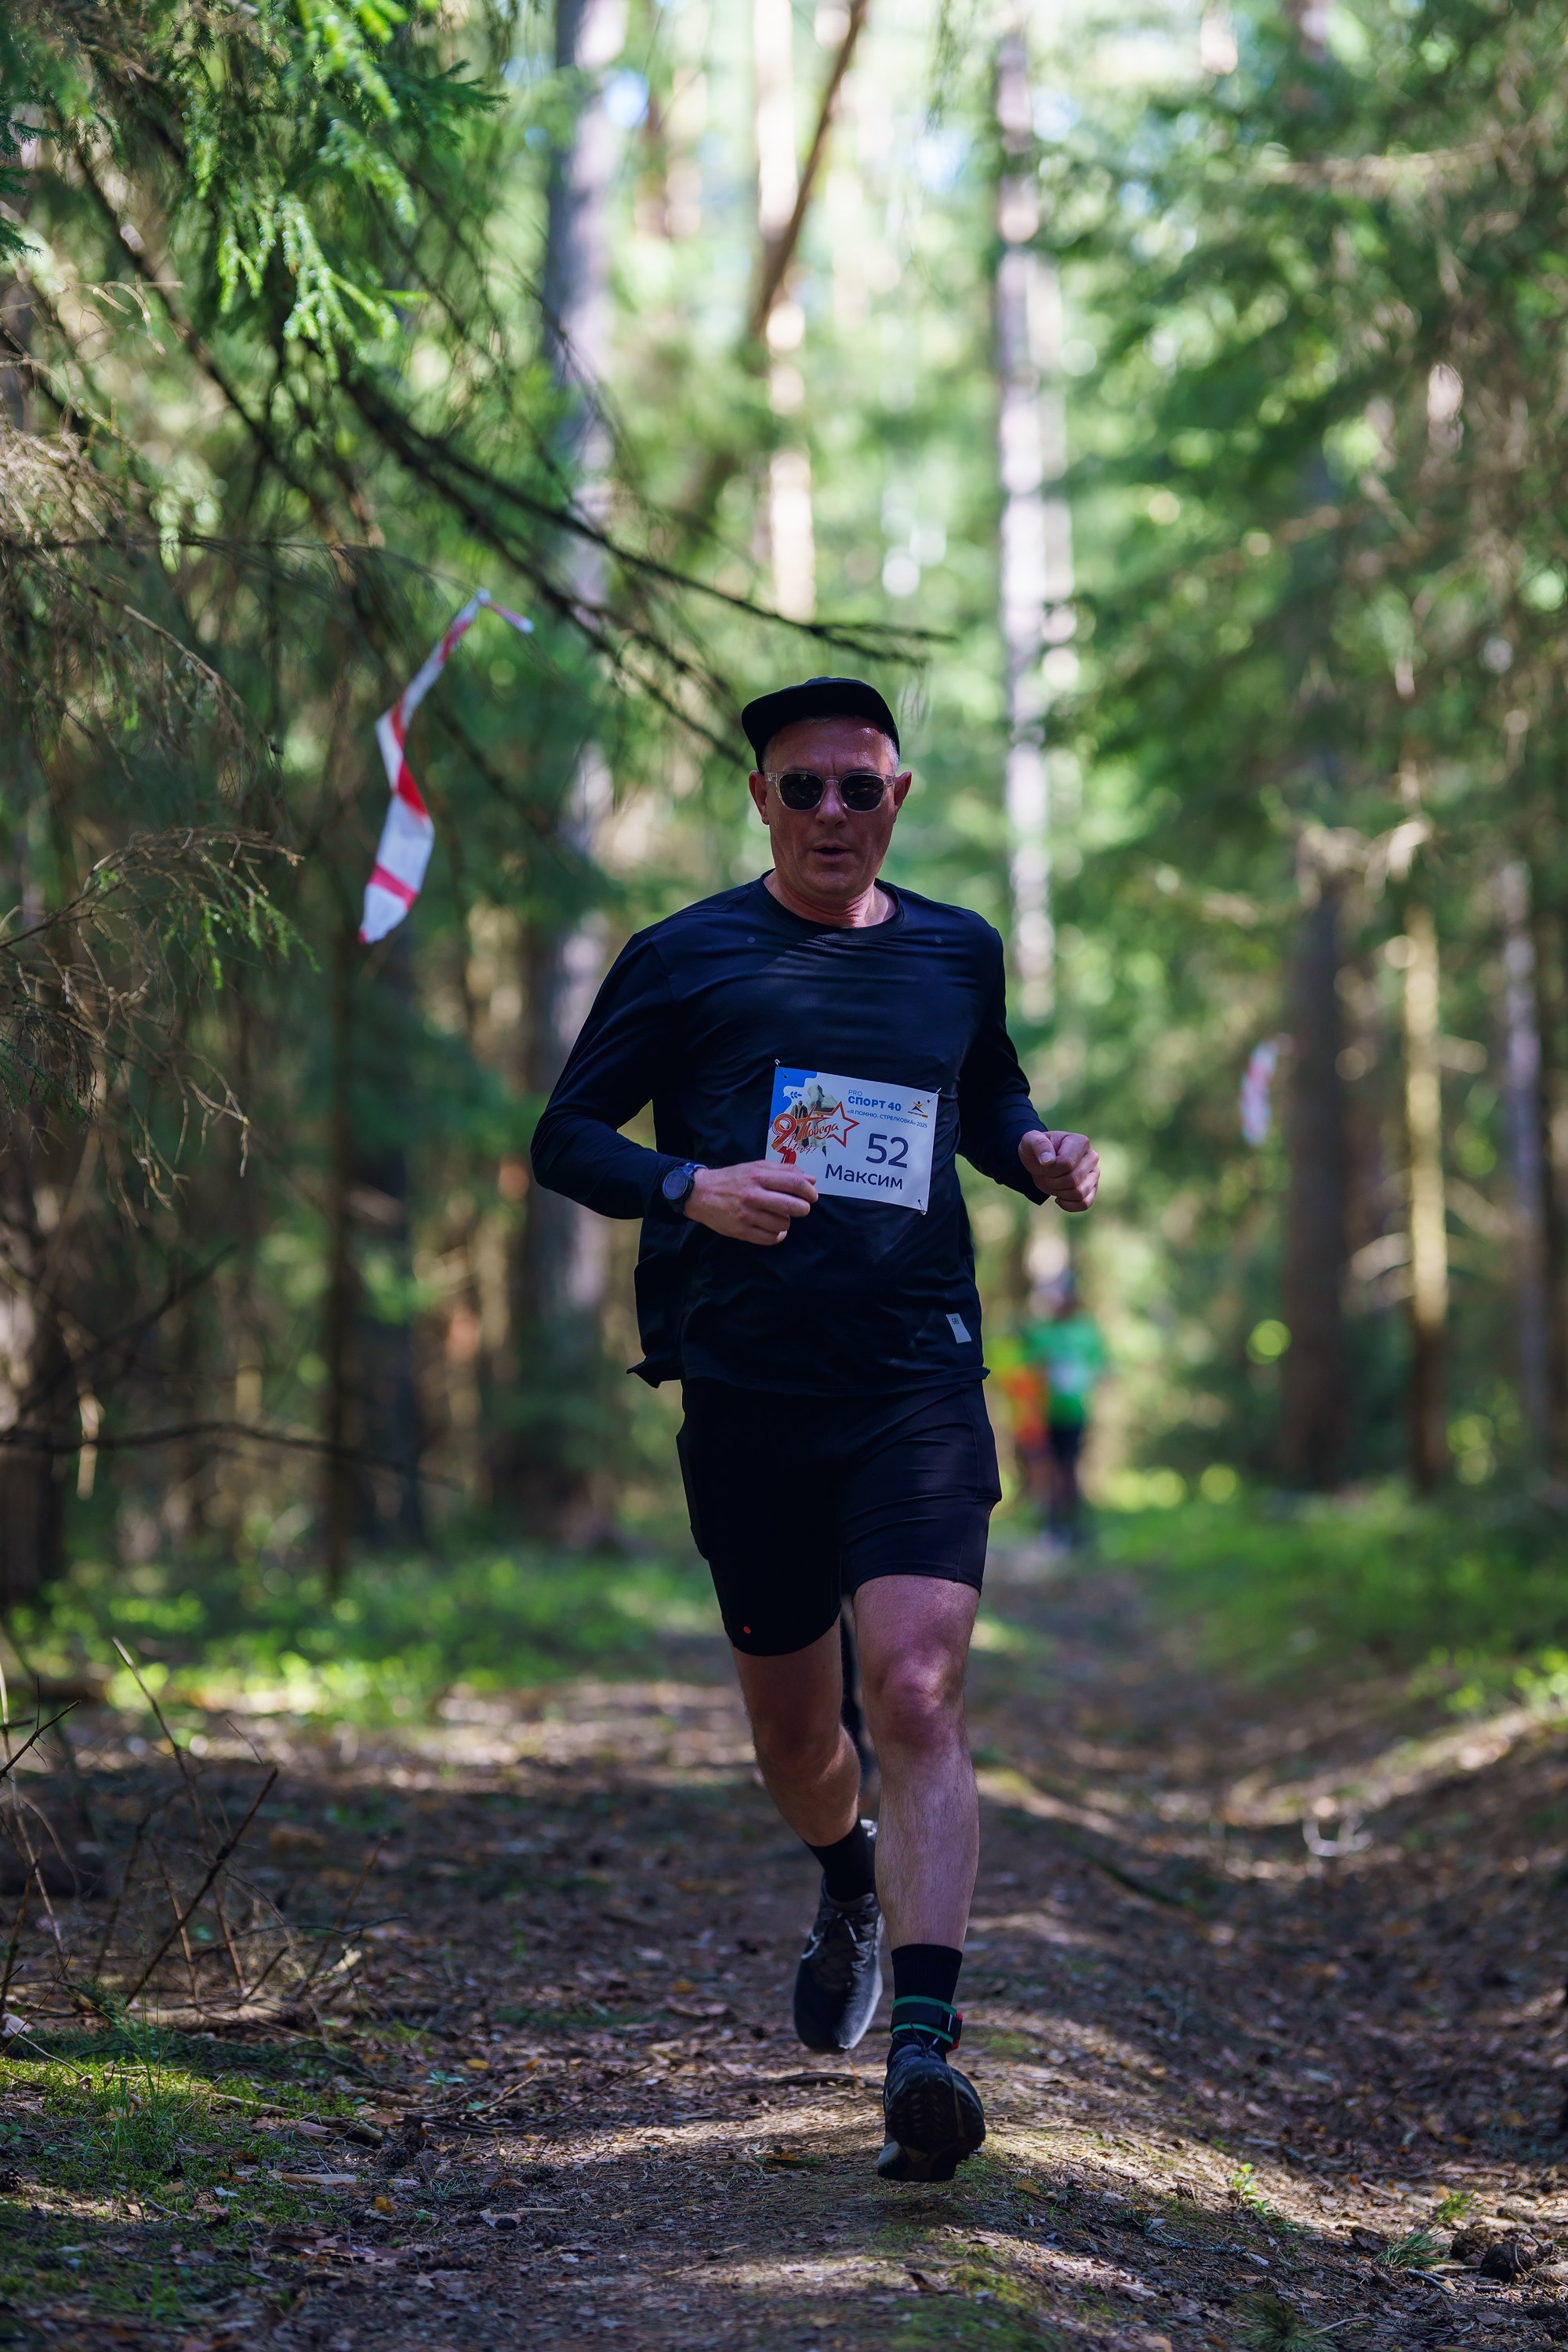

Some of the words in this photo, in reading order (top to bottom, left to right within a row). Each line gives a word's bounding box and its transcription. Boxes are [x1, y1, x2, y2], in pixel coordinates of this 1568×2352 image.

[848, 1096, 886, 1109] СПОРТ
[887, 1102, 902, 1112] 40
[865, 1133, 909, 1168] 52
[825, 1163, 903, 1190] Максим
